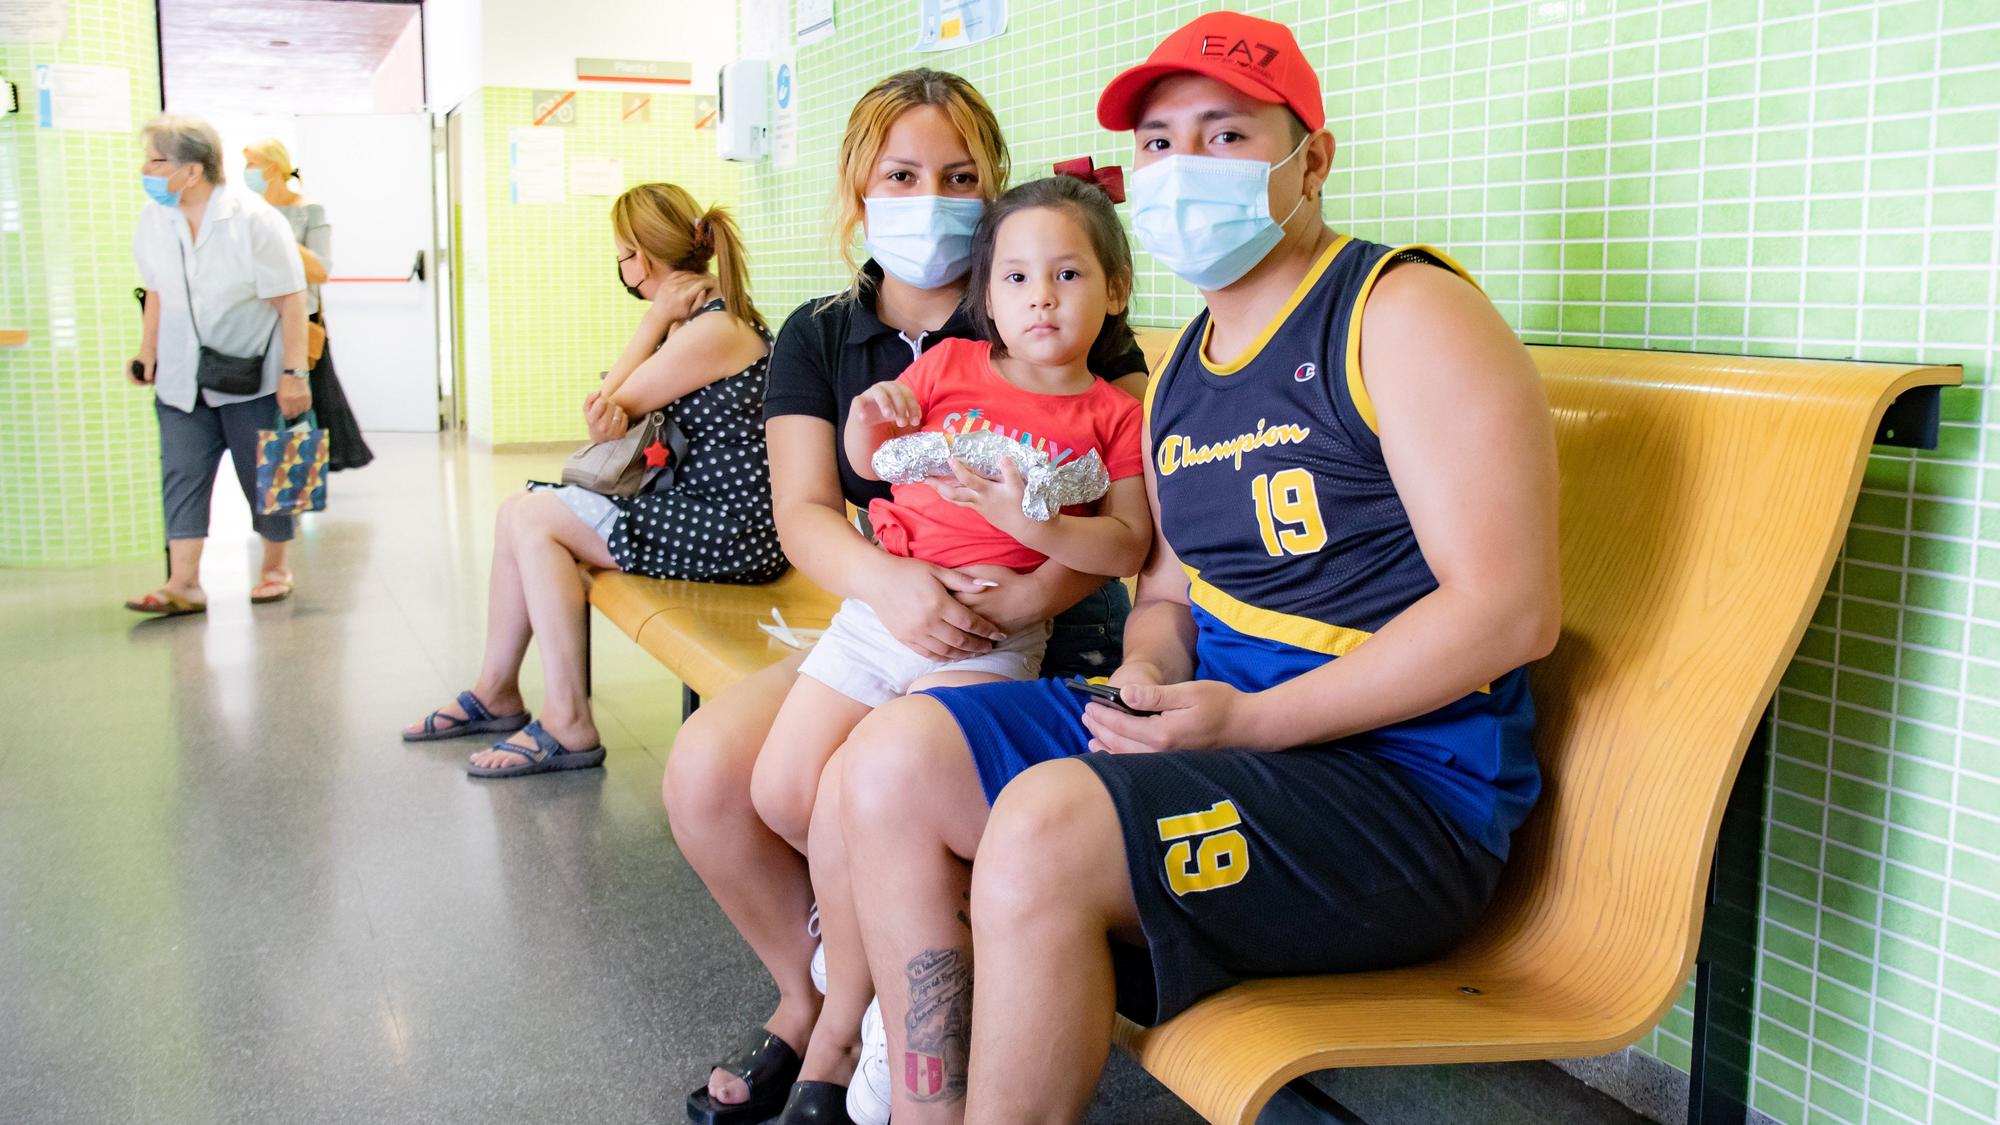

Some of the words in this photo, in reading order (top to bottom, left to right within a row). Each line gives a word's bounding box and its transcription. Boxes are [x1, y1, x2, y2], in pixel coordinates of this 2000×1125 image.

[1201, 35, 1280, 68] EA7
[1158, 418, 1310, 476] Champion
[1252, 467, 1328, 557] 19
[1157, 800, 1249, 896] 19
